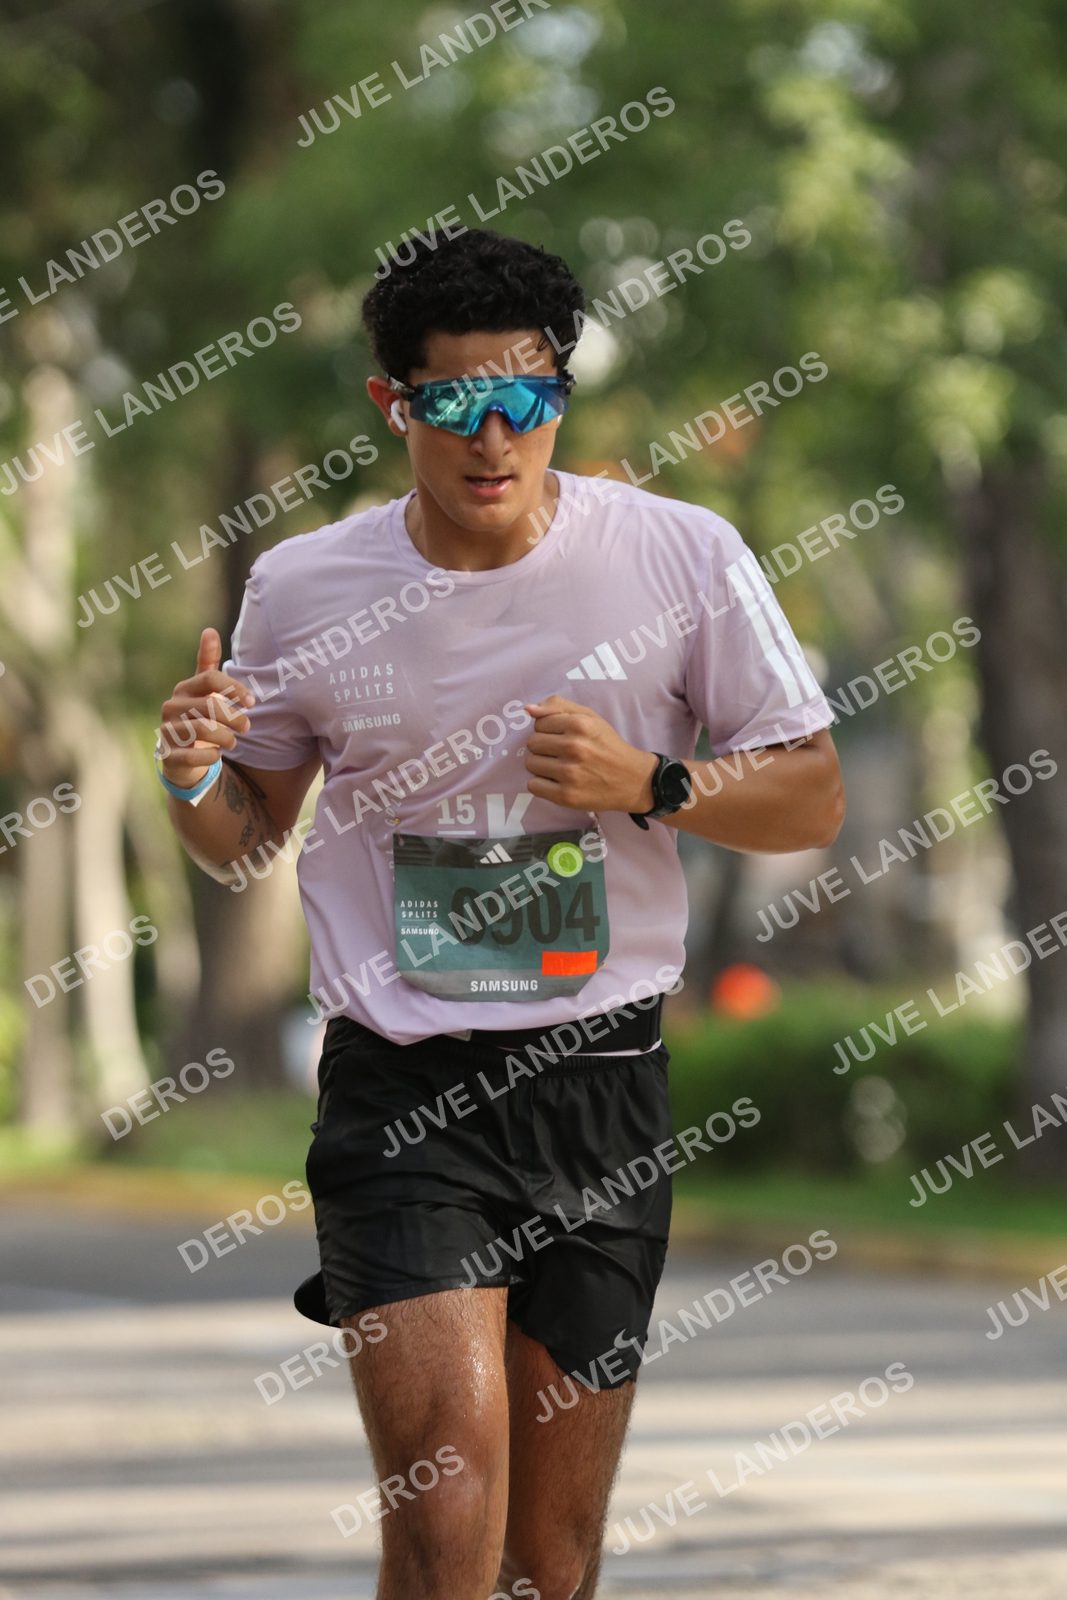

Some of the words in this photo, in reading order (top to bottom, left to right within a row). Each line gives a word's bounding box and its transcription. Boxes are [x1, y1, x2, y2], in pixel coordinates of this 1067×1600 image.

[329, 663, 394, 685] ADIDAS
[334, 682, 394, 703] SPLITS
[342, 713, 401, 732] SAMSUNG
[400, 900, 439, 908] ADIDAS
[401, 910, 438, 919] SPLITS
[451, 881, 600, 945] 0904
[400, 927, 440, 935] SAMSUNG
[470, 980, 539, 992] SAMSUNG
